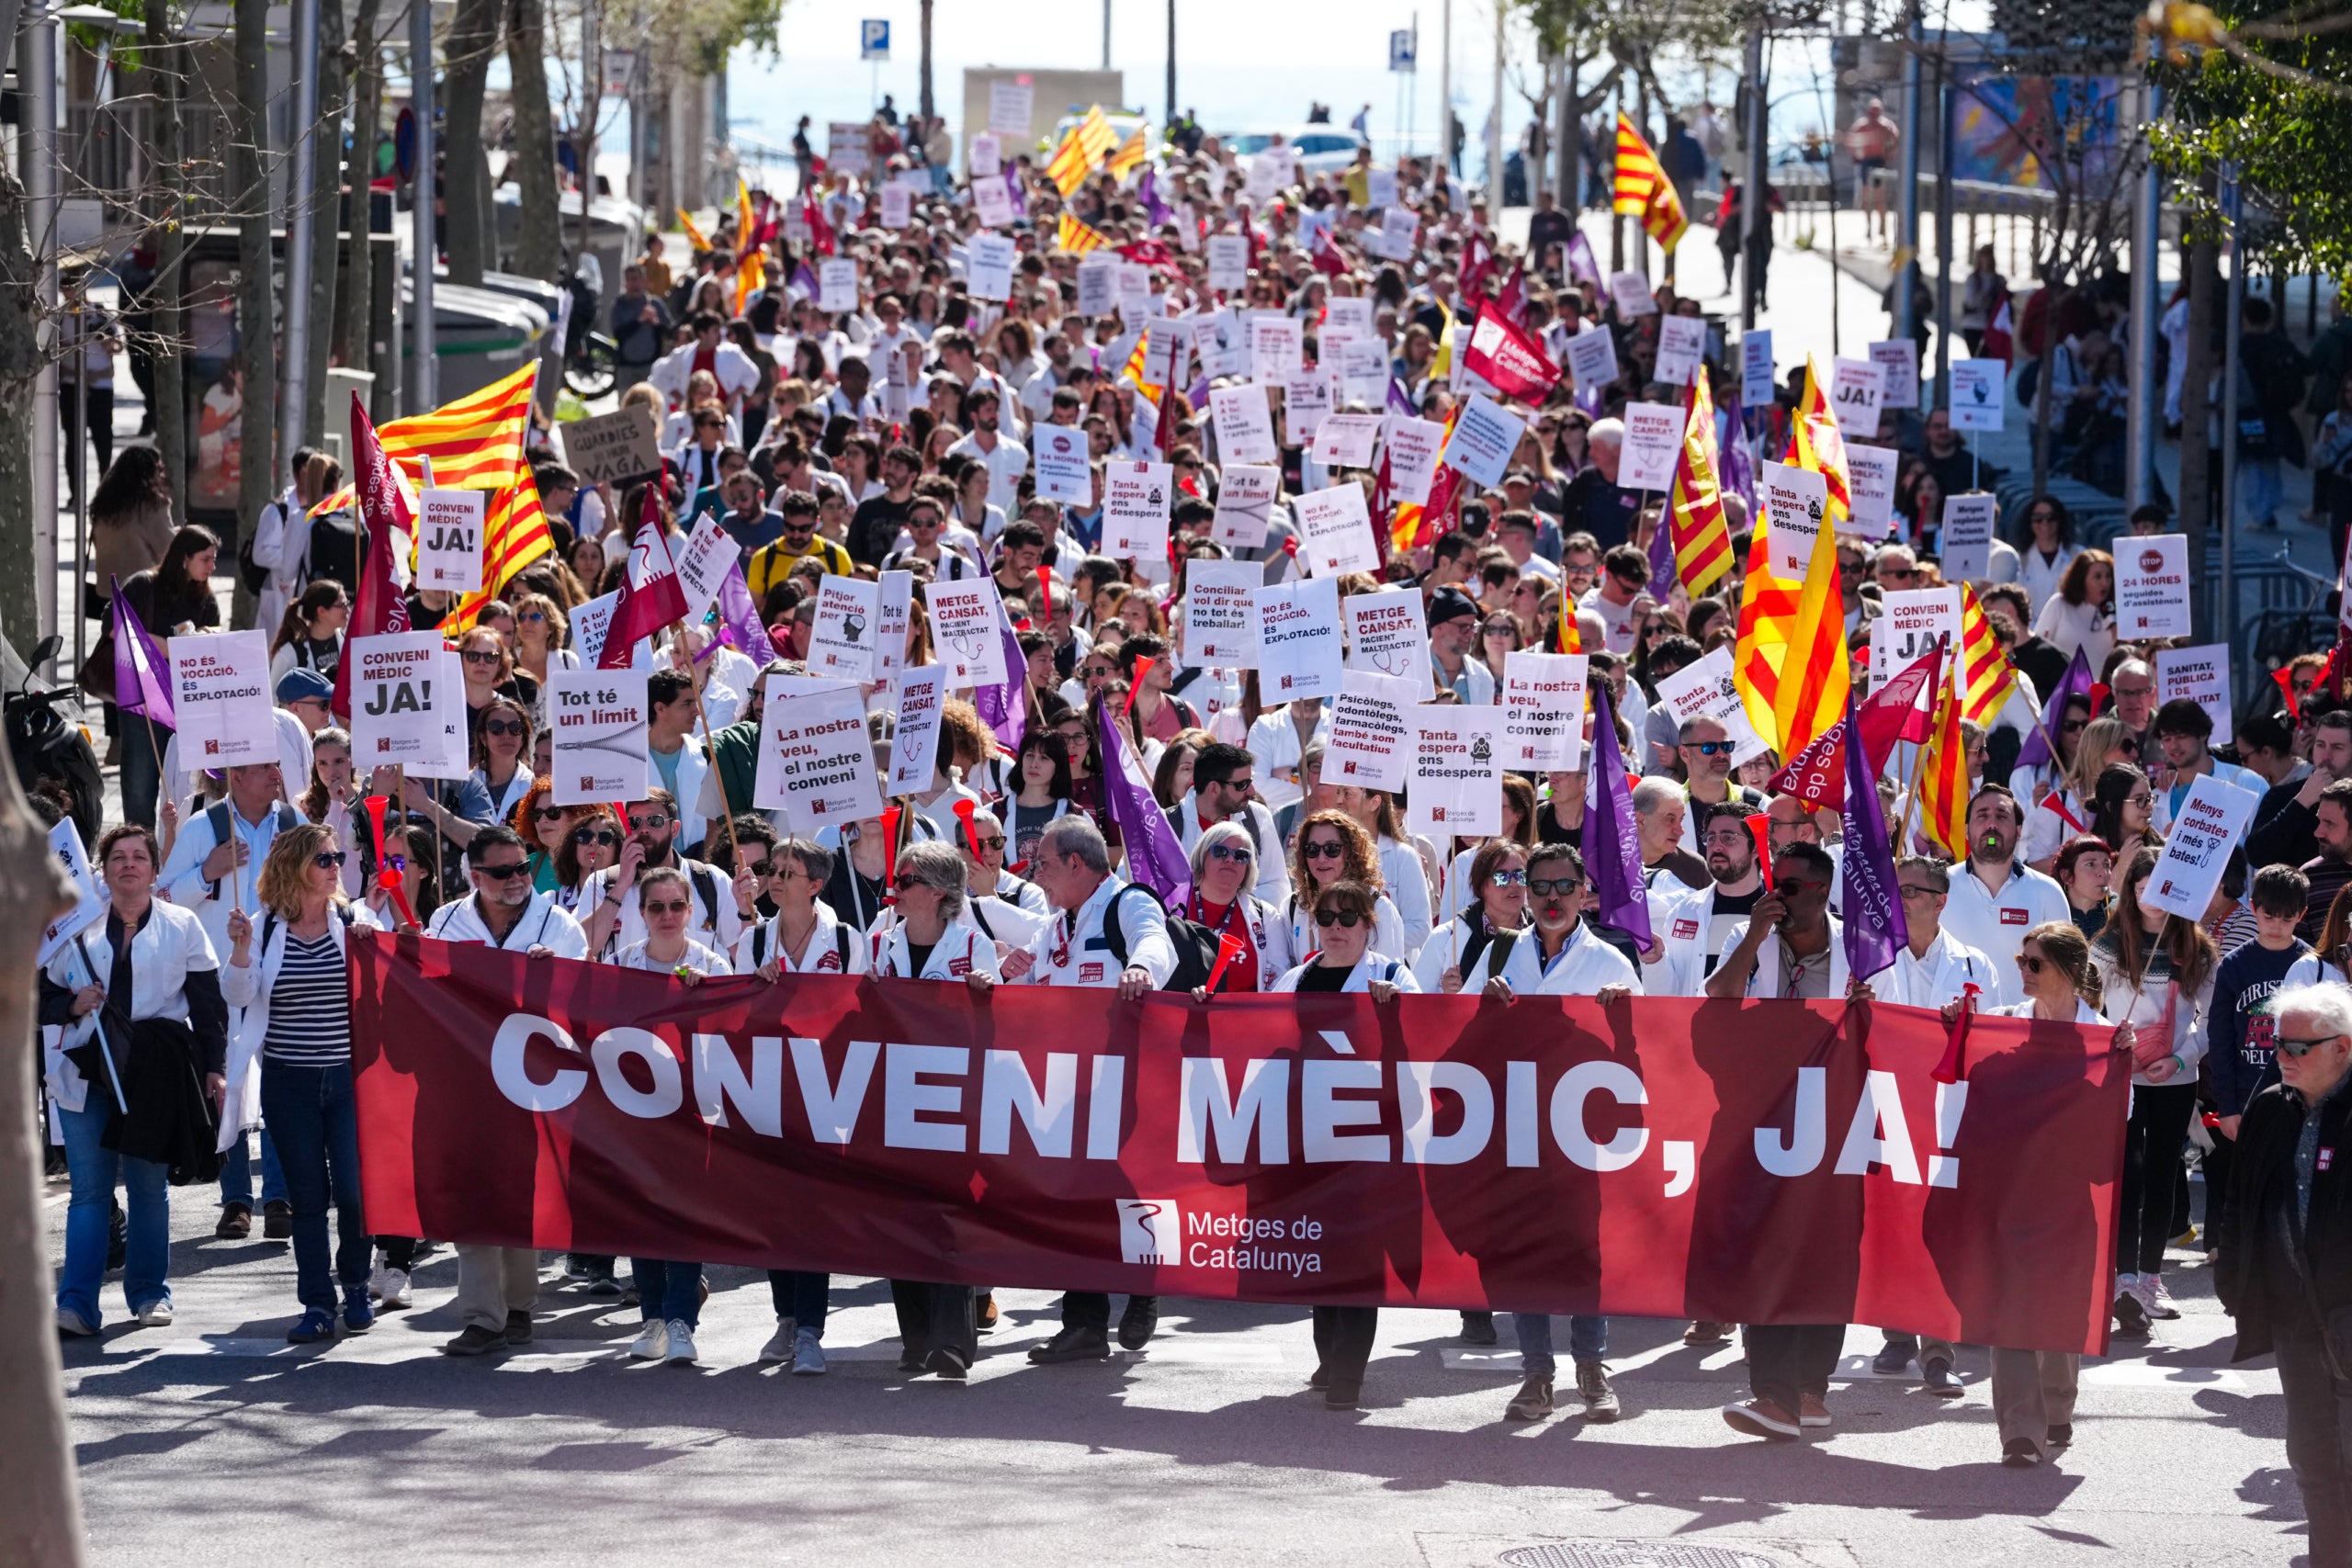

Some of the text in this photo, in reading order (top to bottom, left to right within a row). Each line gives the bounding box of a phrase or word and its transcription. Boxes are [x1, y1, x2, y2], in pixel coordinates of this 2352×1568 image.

[1837, 386, 1876, 407] JA!
[574, 423, 639, 451] GUARDIES
[583, 454, 646, 480] VAGA
[1113, 480, 1139, 490] Tanta
[1227, 476, 1261, 487] Tot té
[1112, 491, 1146, 500] espera
[1242, 489, 1270, 499] límit
[1770, 485, 1797, 500] Tanta
[428, 503, 474, 513] CONVENI
[1111, 499, 1129, 507] ens
[1771, 498, 1805, 512] espera
[427, 513, 462, 525] MÈDIC
[1111, 508, 1162, 518] desespera
[1772, 509, 1790, 519] ens
[1773, 519, 1819, 535] desesper
[427, 527, 474, 552] JA!
[704, 535, 715, 547] tu!
[688, 548, 703, 564] A TU
[700, 544, 710, 557] tu!
[684, 558, 704, 579] TAMBÉ
[2142, 558, 2161, 566] STOP
[679, 566, 708, 597] T'AFECTA!
[2123, 575, 2181, 587] 24 HORES
[823, 588, 856, 603] Pitjor
[1194, 584, 1246, 595] Conciliar
[2123, 590, 2164, 599] seguides
[821, 601, 865, 614] atenció
[936, 594, 979, 607] METGE
[1193, 597, 1253, 608] vol dir que
[2123, 596, 2183, 608] d'assistència
[883, 604, 902, 617] Tot té
[939, 606, 989, 620] CANSAT,
[1193, 608, 1244, 617] no tot és
[1262, 602, 1292, 615] NO ÉS
[1356, 606, 1406, 622] METGE
[1894, 604, 1948, 616] CONVENI
[581, 608, 605, 625] A tu!
[820, 611, 840, 622] per
[1193, 618, 1246, 629] treballar!
[1263, 609, 1310, 625] VOCACIÓ,
[1894, 617, 1934, 629] MÈDIC
[583, 618, 607, 635] A tu!
[880, 621, 906, 633] un límit
[940, 620, 971, 629] PACIENT
[942, 626, 989, 637] MALTRACTAT
[1264, 625, 1277, 635] ÉS
[1358, 619, 1417, 636] CANSAT,
[594, 629, 606, 638] TU
[1264, 627, 1330, 645] EXPLOTACIÓ!
[1360, 634, 1396, 645] PACIENT
[816, 637, 874, 652] sobresaturaci
[1361, 640, 1417, 654] MALTRACTAT
[1896, 630, 1951, 660] JA!
[180, 656, 216, 668] NO ÉS
[364, 649, 429, 665] CONVENI
[181, 665, 238, 679] VOCACIÓ,
[364, 665, 412, 680] MÈDIC
[2167, 662, 2214, 675] SANITAT,
[1510, 678, 1581, 692] La nostra
[2168, 672, 2214, 685] PÚBLICA
[183, 681, 198, 691] ÉS
[904, 682, 933, 698] METGE
[2176, 686, 2189, 695] DE
[184, 687, 261, 703] EXPLOTACIÓ!
[365, 680, 431, 716] JA!
[559, 688, 617, 706] Tot té
[1509, 695, 1541, 707] veu,
[1674, 685, 1706, 706] Tanta
[902, 697, 935, 713] CANSAT,
[1339, 694, 1396, 711] Psicòlegs,
[1680, 691, 1718, 716] espera
[560, 707, 638, 727] un límit
[900, 713, 922, 724] PACIENT
[1337, 705, 1402, 724] odontòlegs,
[1508, 709, 1574, 721] el nostre
[777, 717, 861, 742] La nostra
[899, 722, 931, 734] MALTRACTAT
[1335, 716, 1408, 736] farmacòlegs,
[1507, 723, 1566, 736] conveni
[1333, 728, 1395, 744] també som
[1419, 729, 1457, 741] Tanta
[781, 742, 818, 759] veu,
[1331, 739, 1391, 755] facultatius
[1419, 742, 1466, 755] espera
[784, 751, 862, 775] el nostre
[1419, 755, 1443, 765] ens
[1419, 767, 1492, 779] desespera
[788, 769, 856, 792] conveni
[1805, 773, 1828, 799] de
[2190, 798, 2224, 818] Menys
[2184, 817, 2229, 839] corbates
[2176, 830, 2203, 848] i més
[2169, 846, 2200, 865] bates!
[1843, 811, 1893, 919] Metgesses de
[490, 1011, 1970, 1199] CONVENI MÈDIC, JA!
[1188, 1212, 1322, 1244] Metges de
[1189, 1242, 1321, 1278] Catalunya
